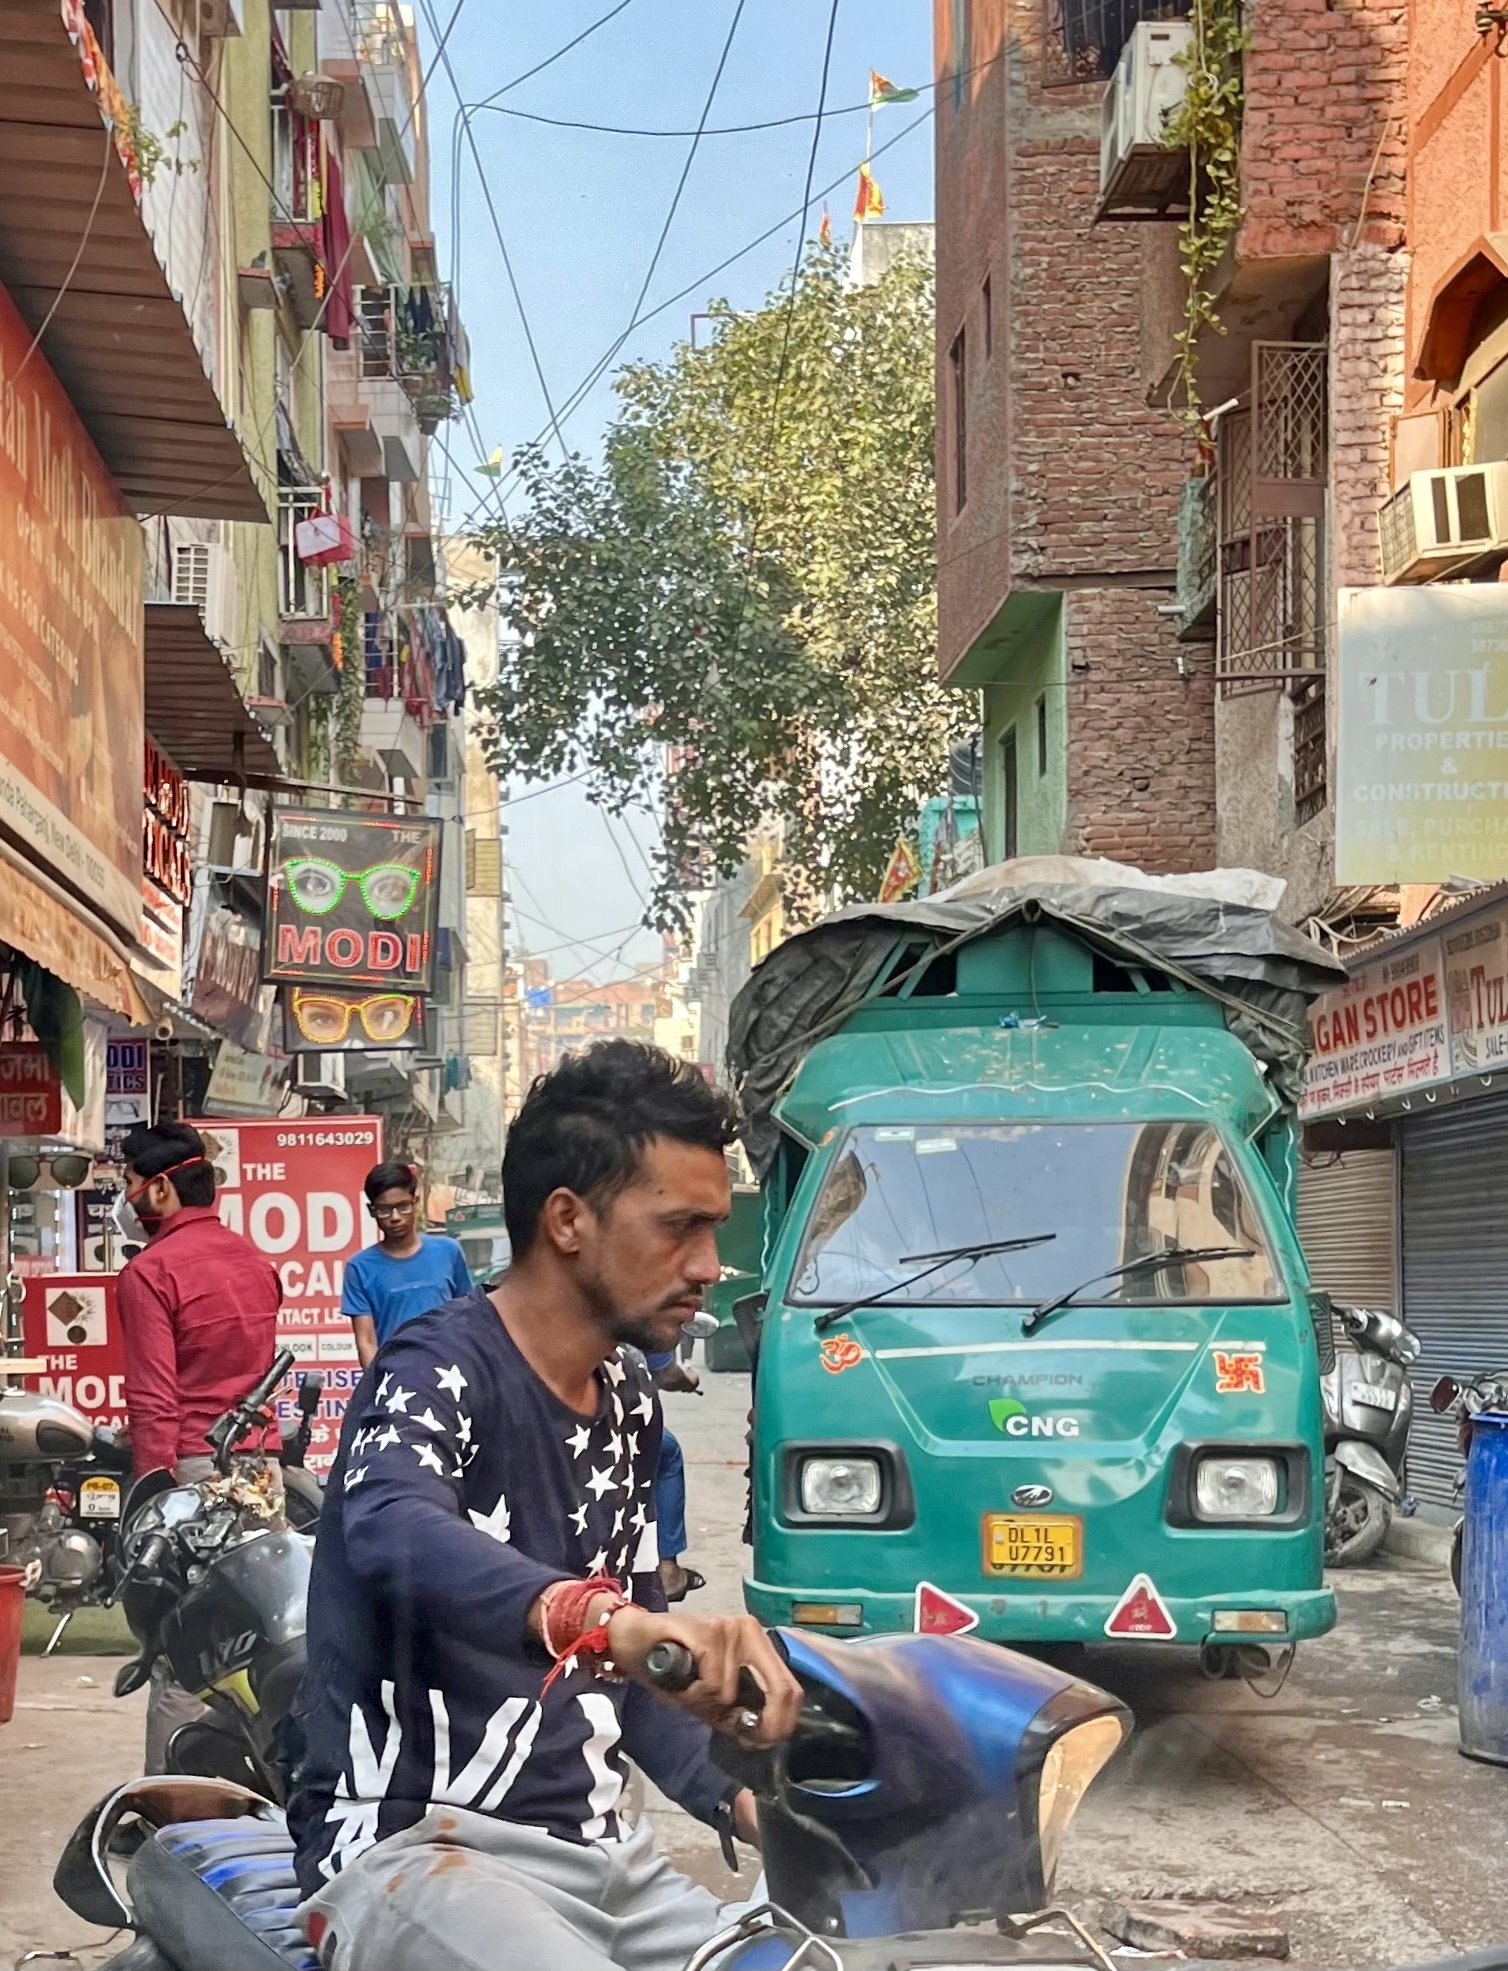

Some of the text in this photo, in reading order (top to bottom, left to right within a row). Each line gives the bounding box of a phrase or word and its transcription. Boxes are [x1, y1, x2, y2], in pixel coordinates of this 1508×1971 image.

[81, 470, 139, 648] Bhandar
[21, 588, 38, 637] FOR
[40, 614, 78, 687] CATERING
[1441, 757, 1458, 775] &
[282, 823, 422, 844] SINCE 2000 THE
[278, 924, 421, 973] MODI
[1308, 1002, 1361, 1057] GAN
[1364, 973, 1438, 1040] STORE
[1424, 1023, 1445, 1049] ITEMS
[276, 1131, 374, 1147] 9811643029
[242, 1163, 287, 1181] THE
[321, 1341, 353, 1352] COLOUR
[37, 1354, 78, 1371] THE
[972, 1374, 1083, 1386] CHAMPION
[1006, 1416, 1080, 1437] CNG
[1008, 1545, 1066, 1562] U7791
